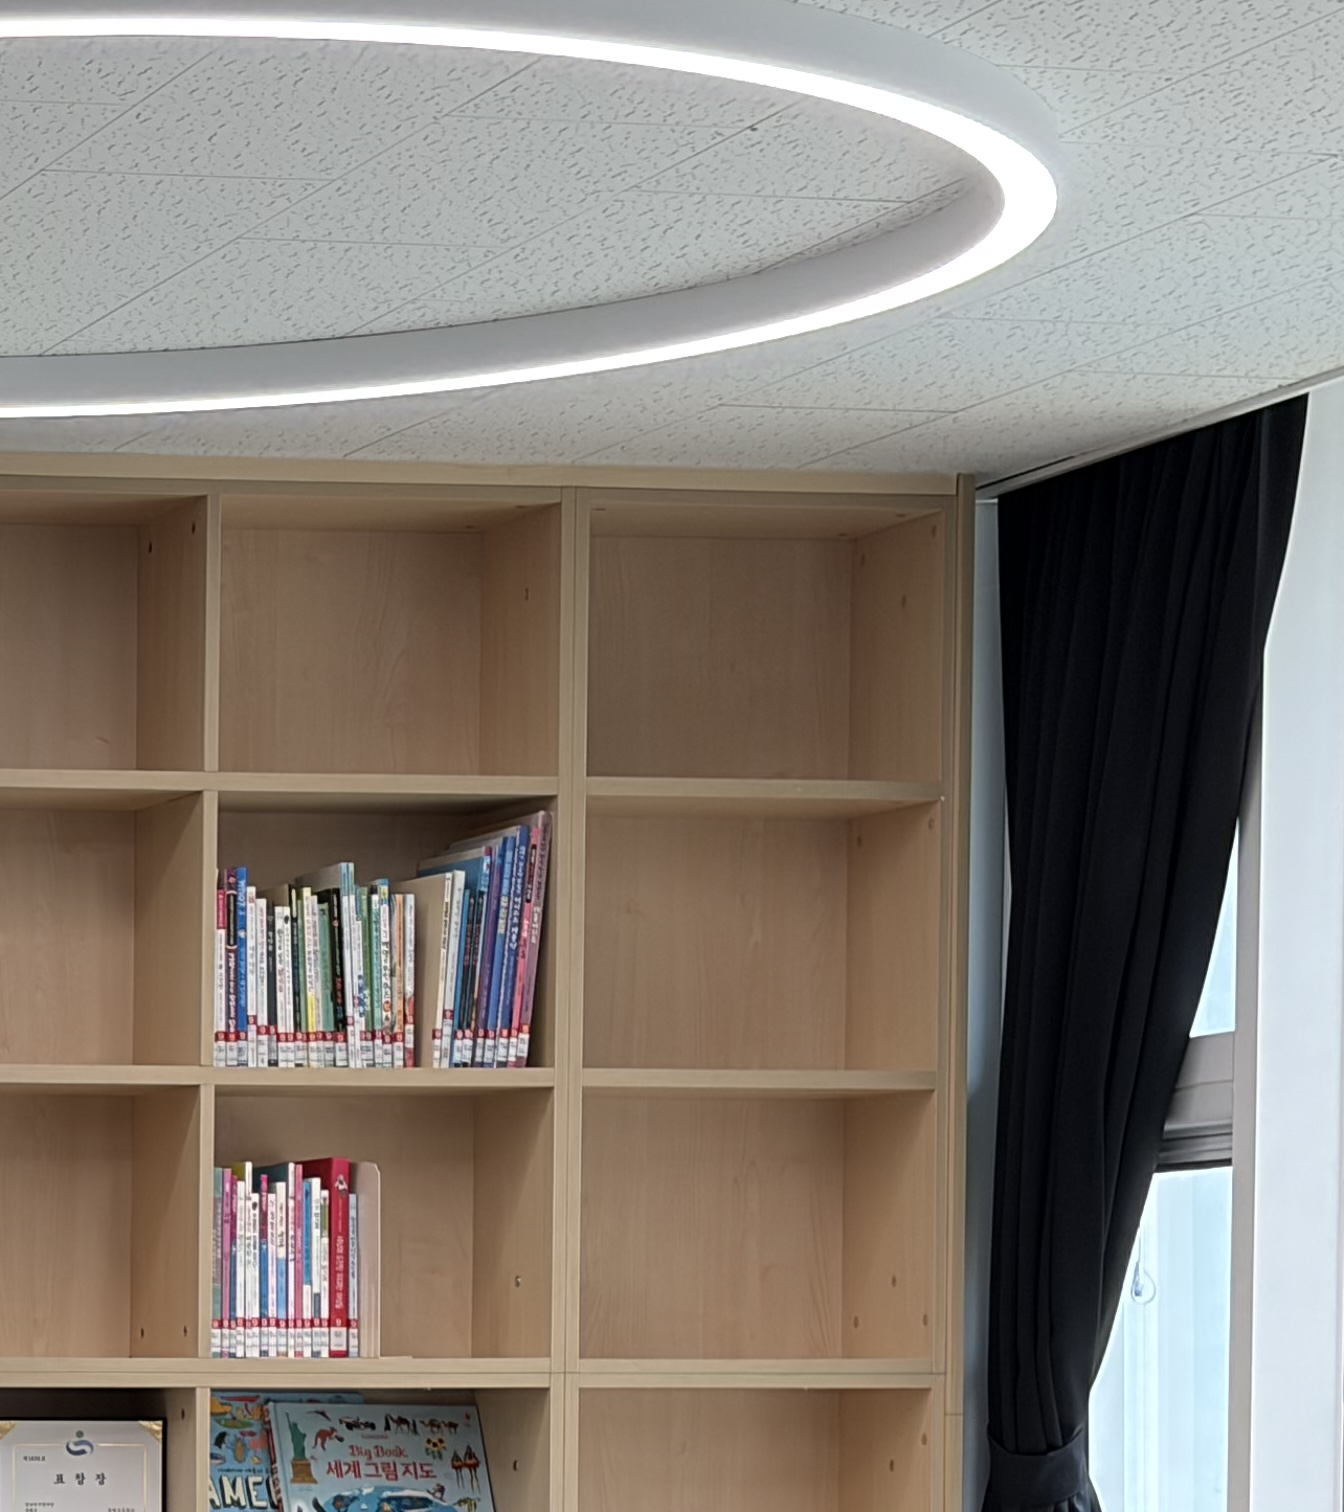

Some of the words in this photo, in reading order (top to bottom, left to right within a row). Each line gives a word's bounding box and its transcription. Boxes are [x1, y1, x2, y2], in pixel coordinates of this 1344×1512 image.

[326, 1461, 362, 1479] 세계
[364, 1462, 399, 1481] 그림
[402, 1463, 438, 1480] 지도
[210, 1475, 280, 1509] AME
